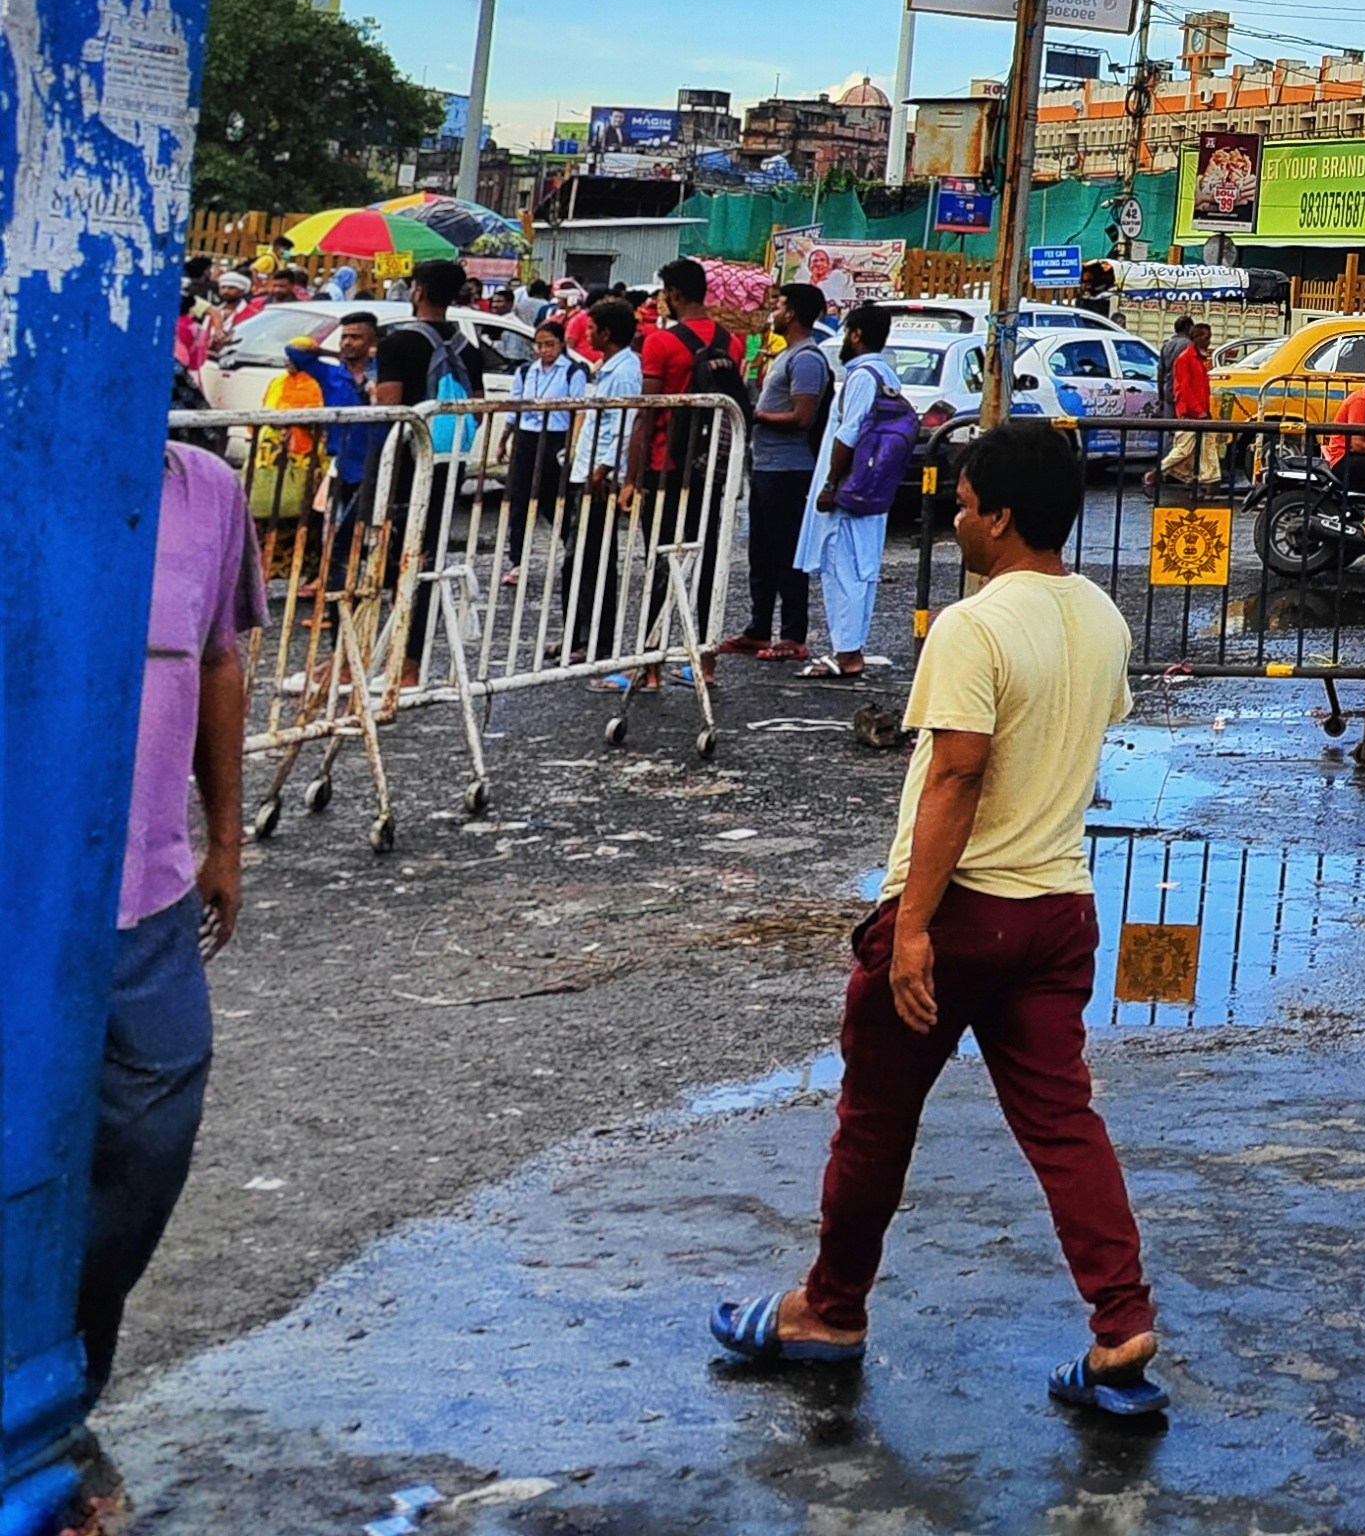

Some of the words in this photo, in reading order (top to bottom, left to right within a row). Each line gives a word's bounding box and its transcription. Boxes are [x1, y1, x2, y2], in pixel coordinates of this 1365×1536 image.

[1261, 159, 1284, 181] LET
[1285, 156, 1317, 180] YOUR
[1323, 154, 1365, 179] BRAND
[1125, 208, 1138, 220] 42
